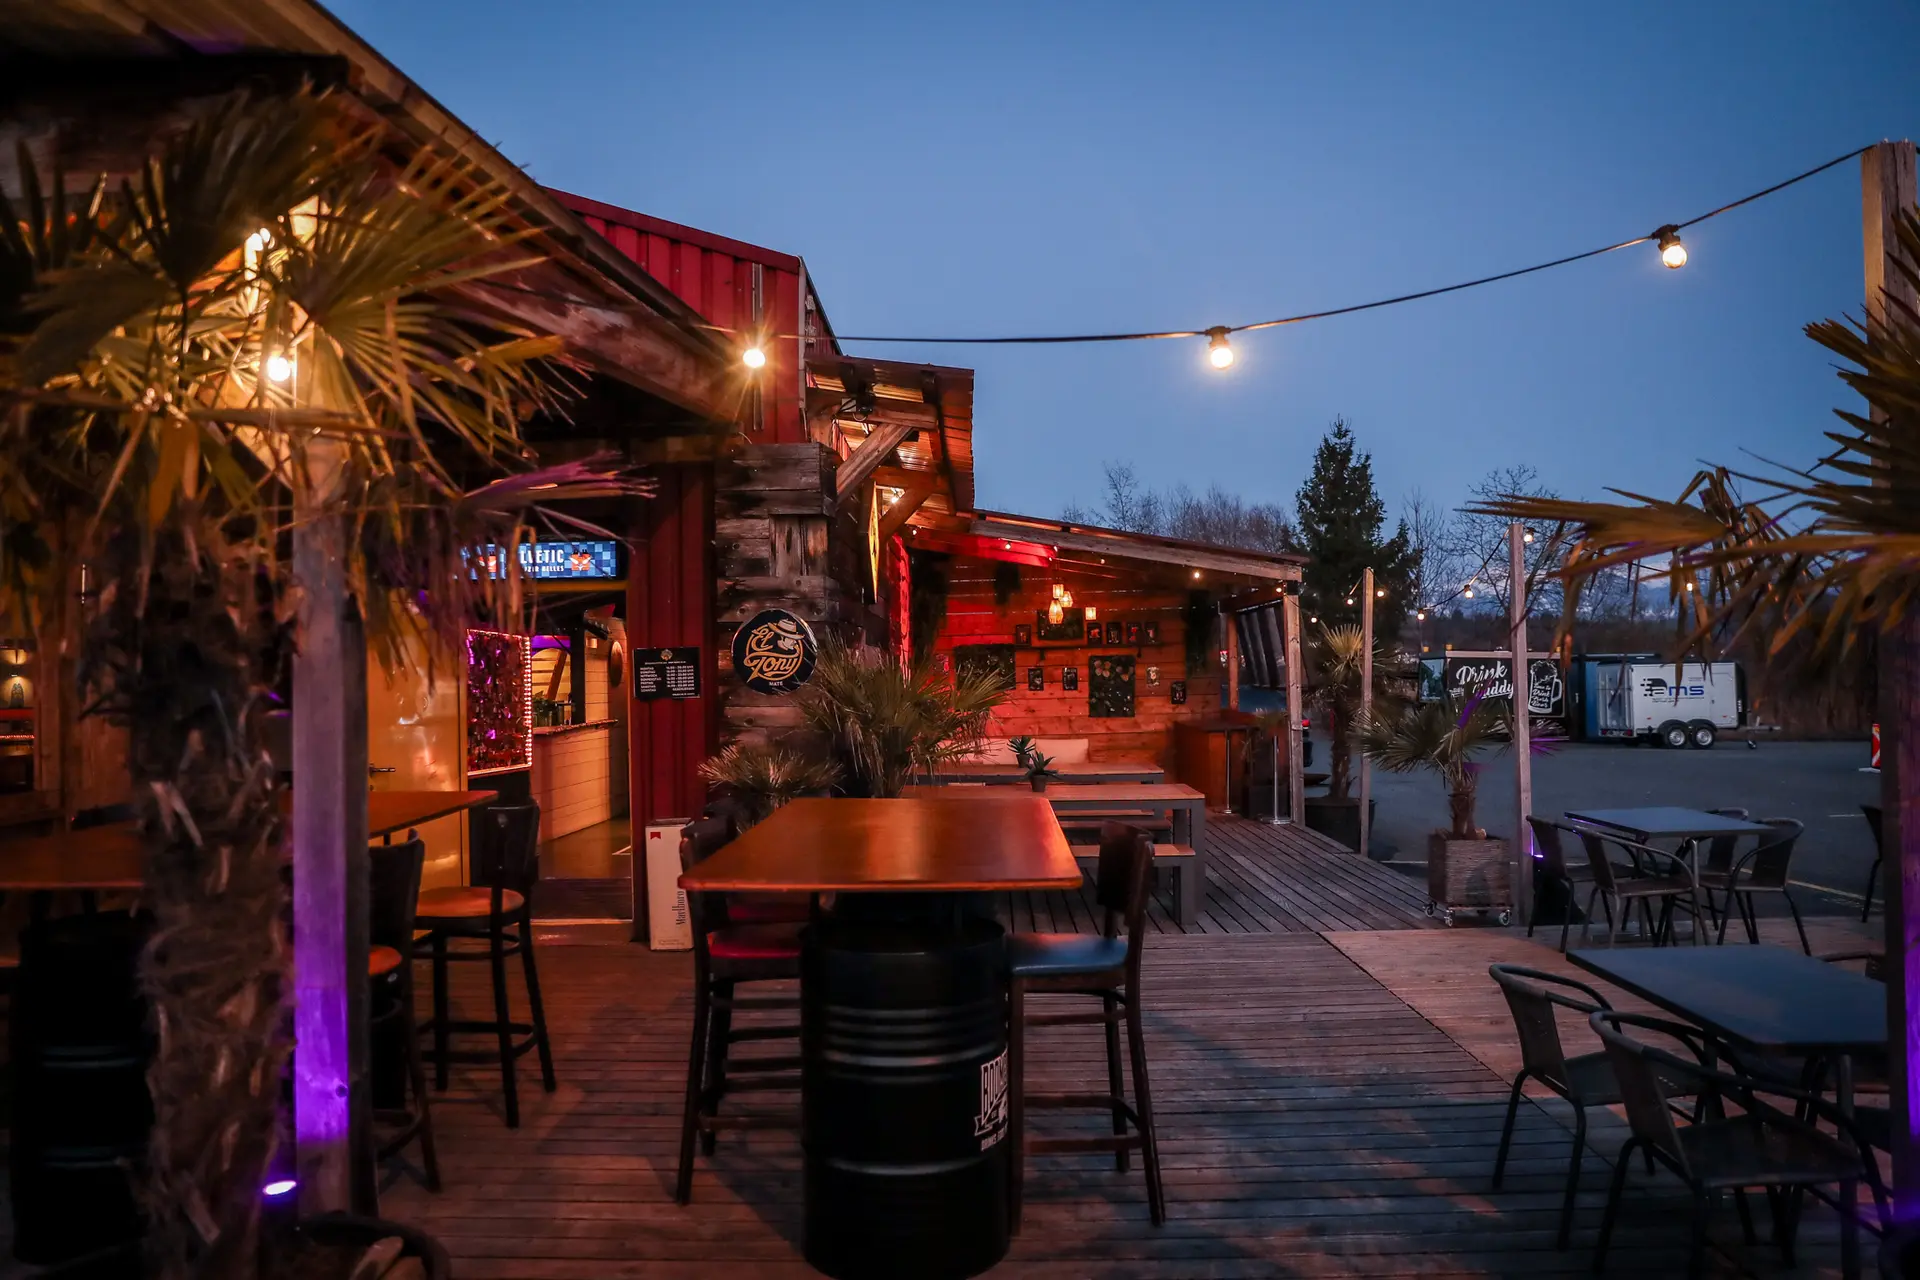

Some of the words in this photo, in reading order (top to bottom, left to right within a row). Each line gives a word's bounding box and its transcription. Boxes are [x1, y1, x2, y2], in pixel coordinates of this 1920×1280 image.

[751, 627, 775, 652] El
[743, 651, 799, 683] Tony
[1455, 660, 1508, 685] Drink
[1472, 680, 1514, 699] uddy
[671, 890, 686, 925] Marlboro
